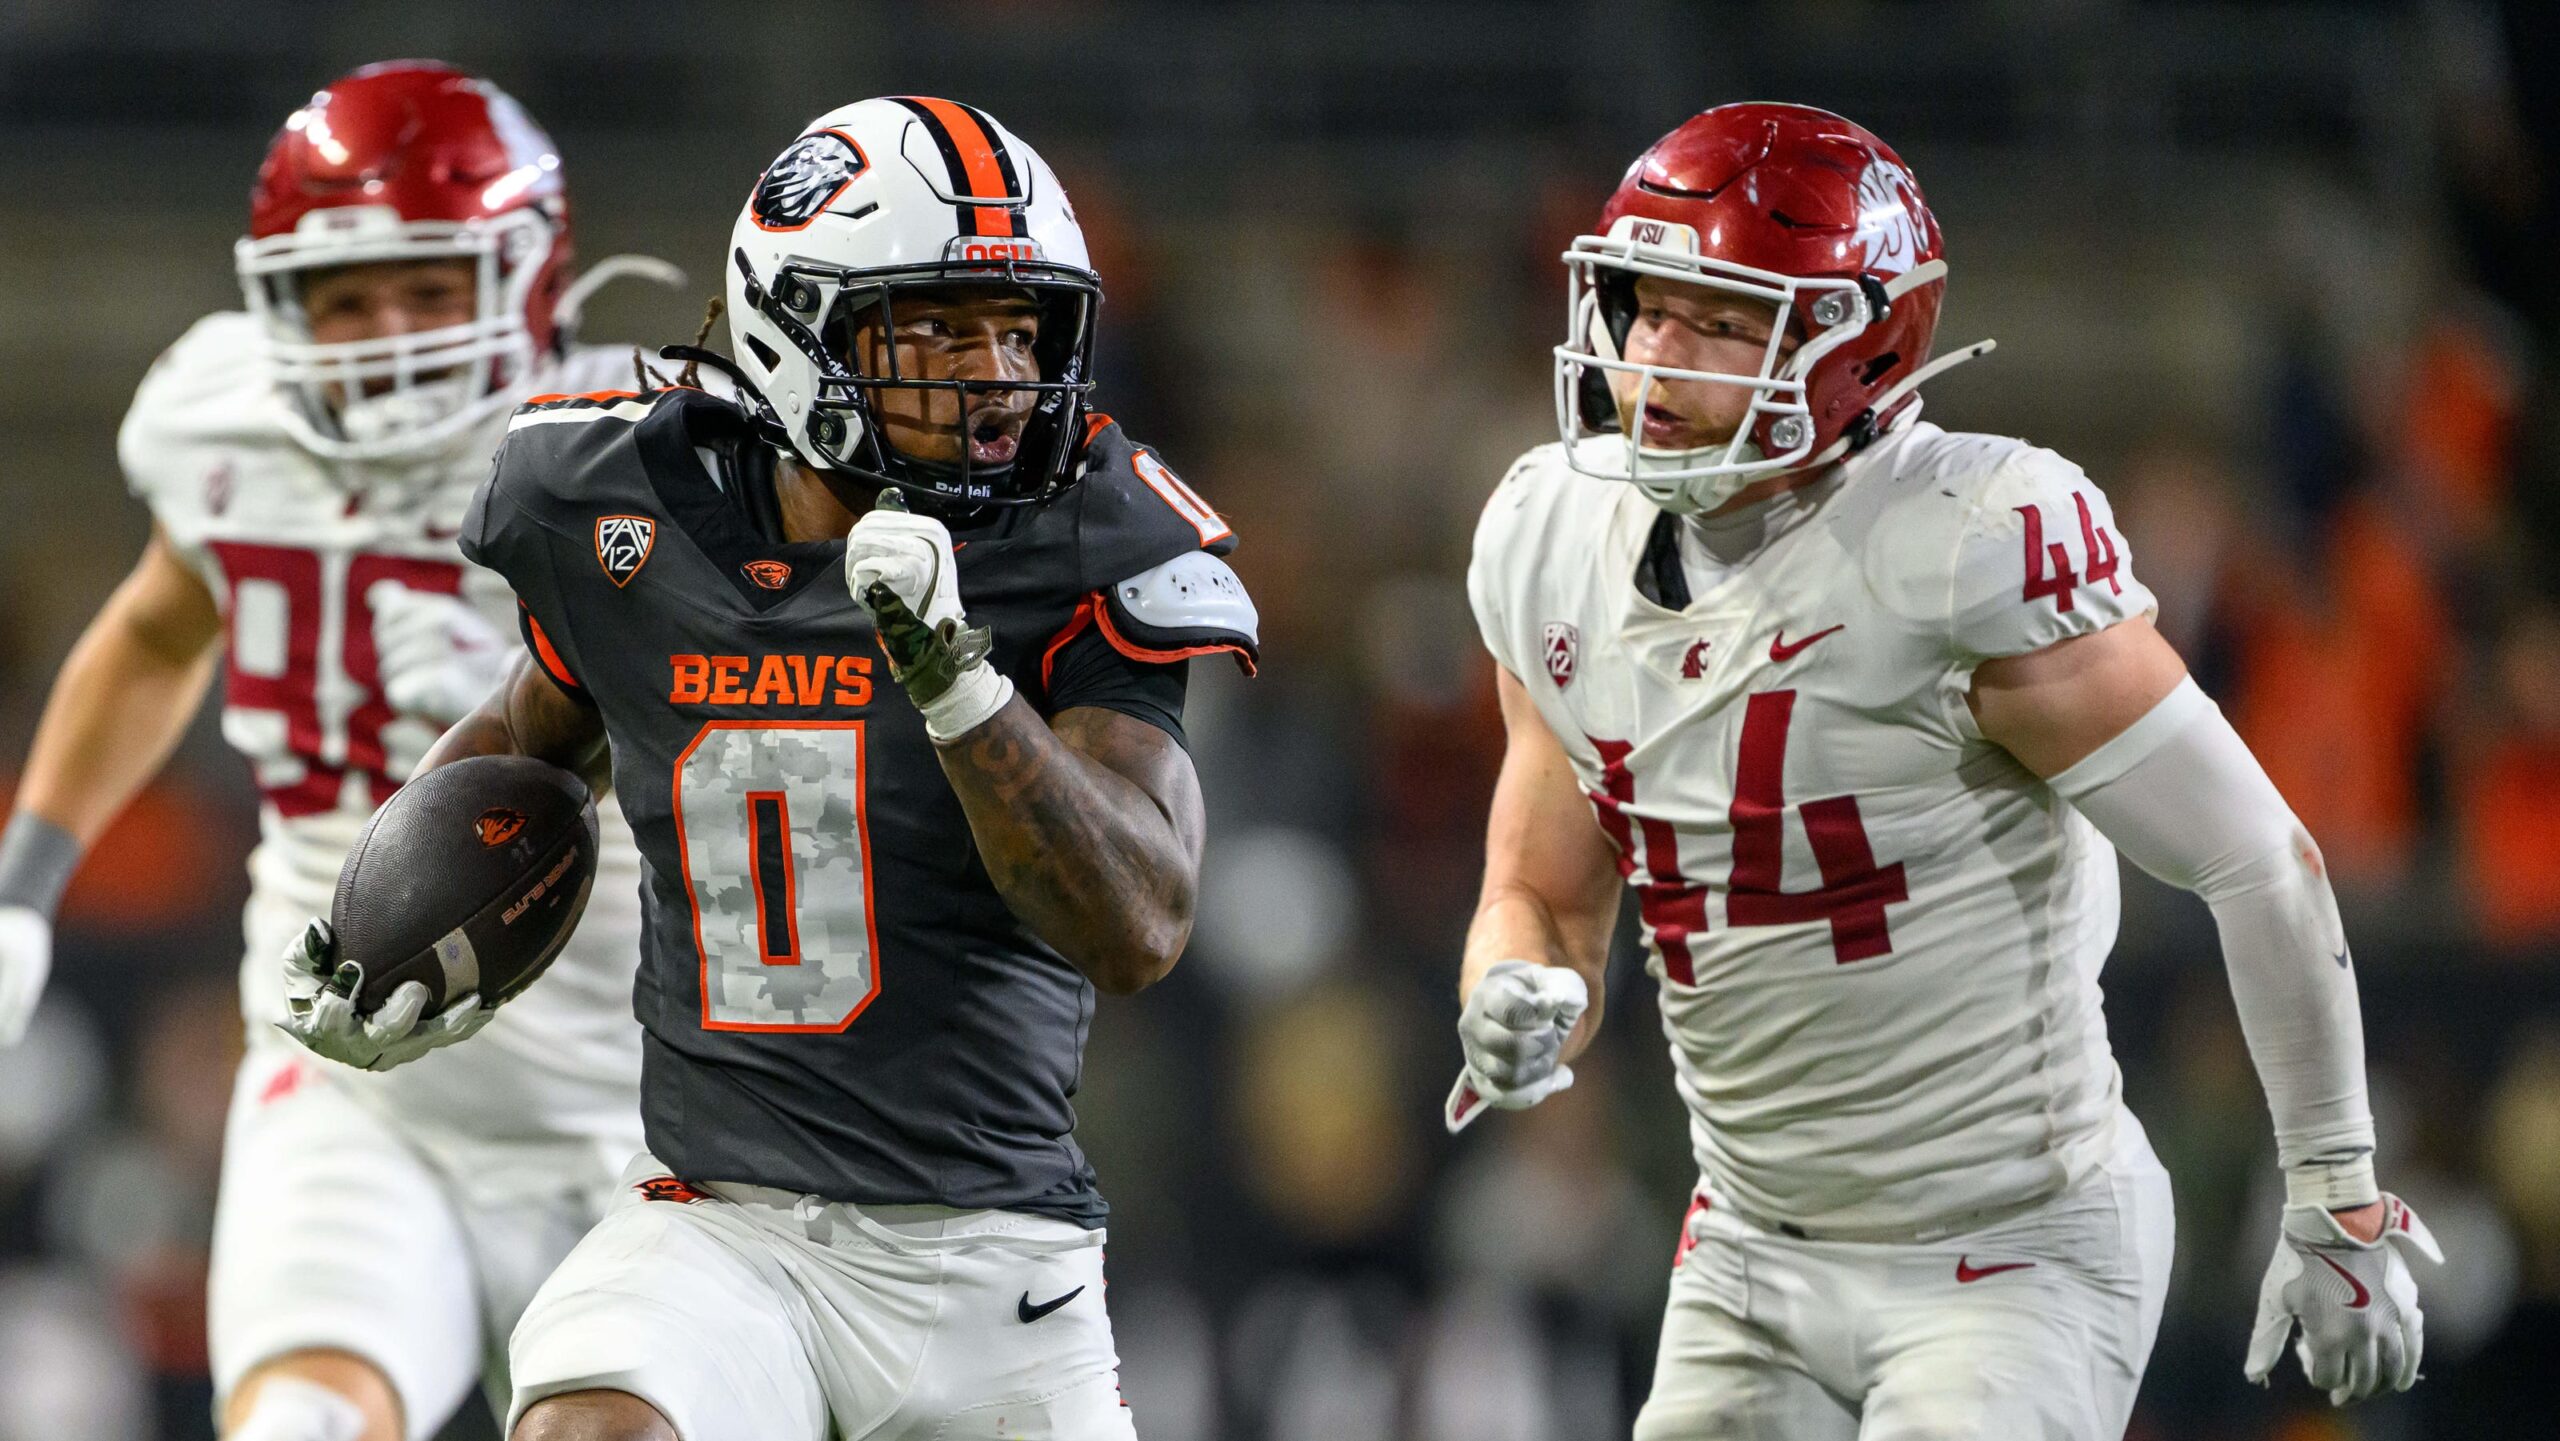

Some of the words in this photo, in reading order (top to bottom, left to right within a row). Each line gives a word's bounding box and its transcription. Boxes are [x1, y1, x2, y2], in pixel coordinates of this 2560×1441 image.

[1630, 221, 1666, 246] WSU
[964, 244, 1033, 272] OSU
[935, 481, 992, 499] Ridell
[599, 518, 651, 558] PAC
[608, 545, 636, 571] 12
[2011, 490, 2122, 614] 44
[669, 654, 873, 706] BEAVS
[1552, 651, 1571, 675] 12
[1586, 689, 1910, 988] 44
[673, 719, 882, 1034] 0
[501, 881, 546, 925] ELITE
